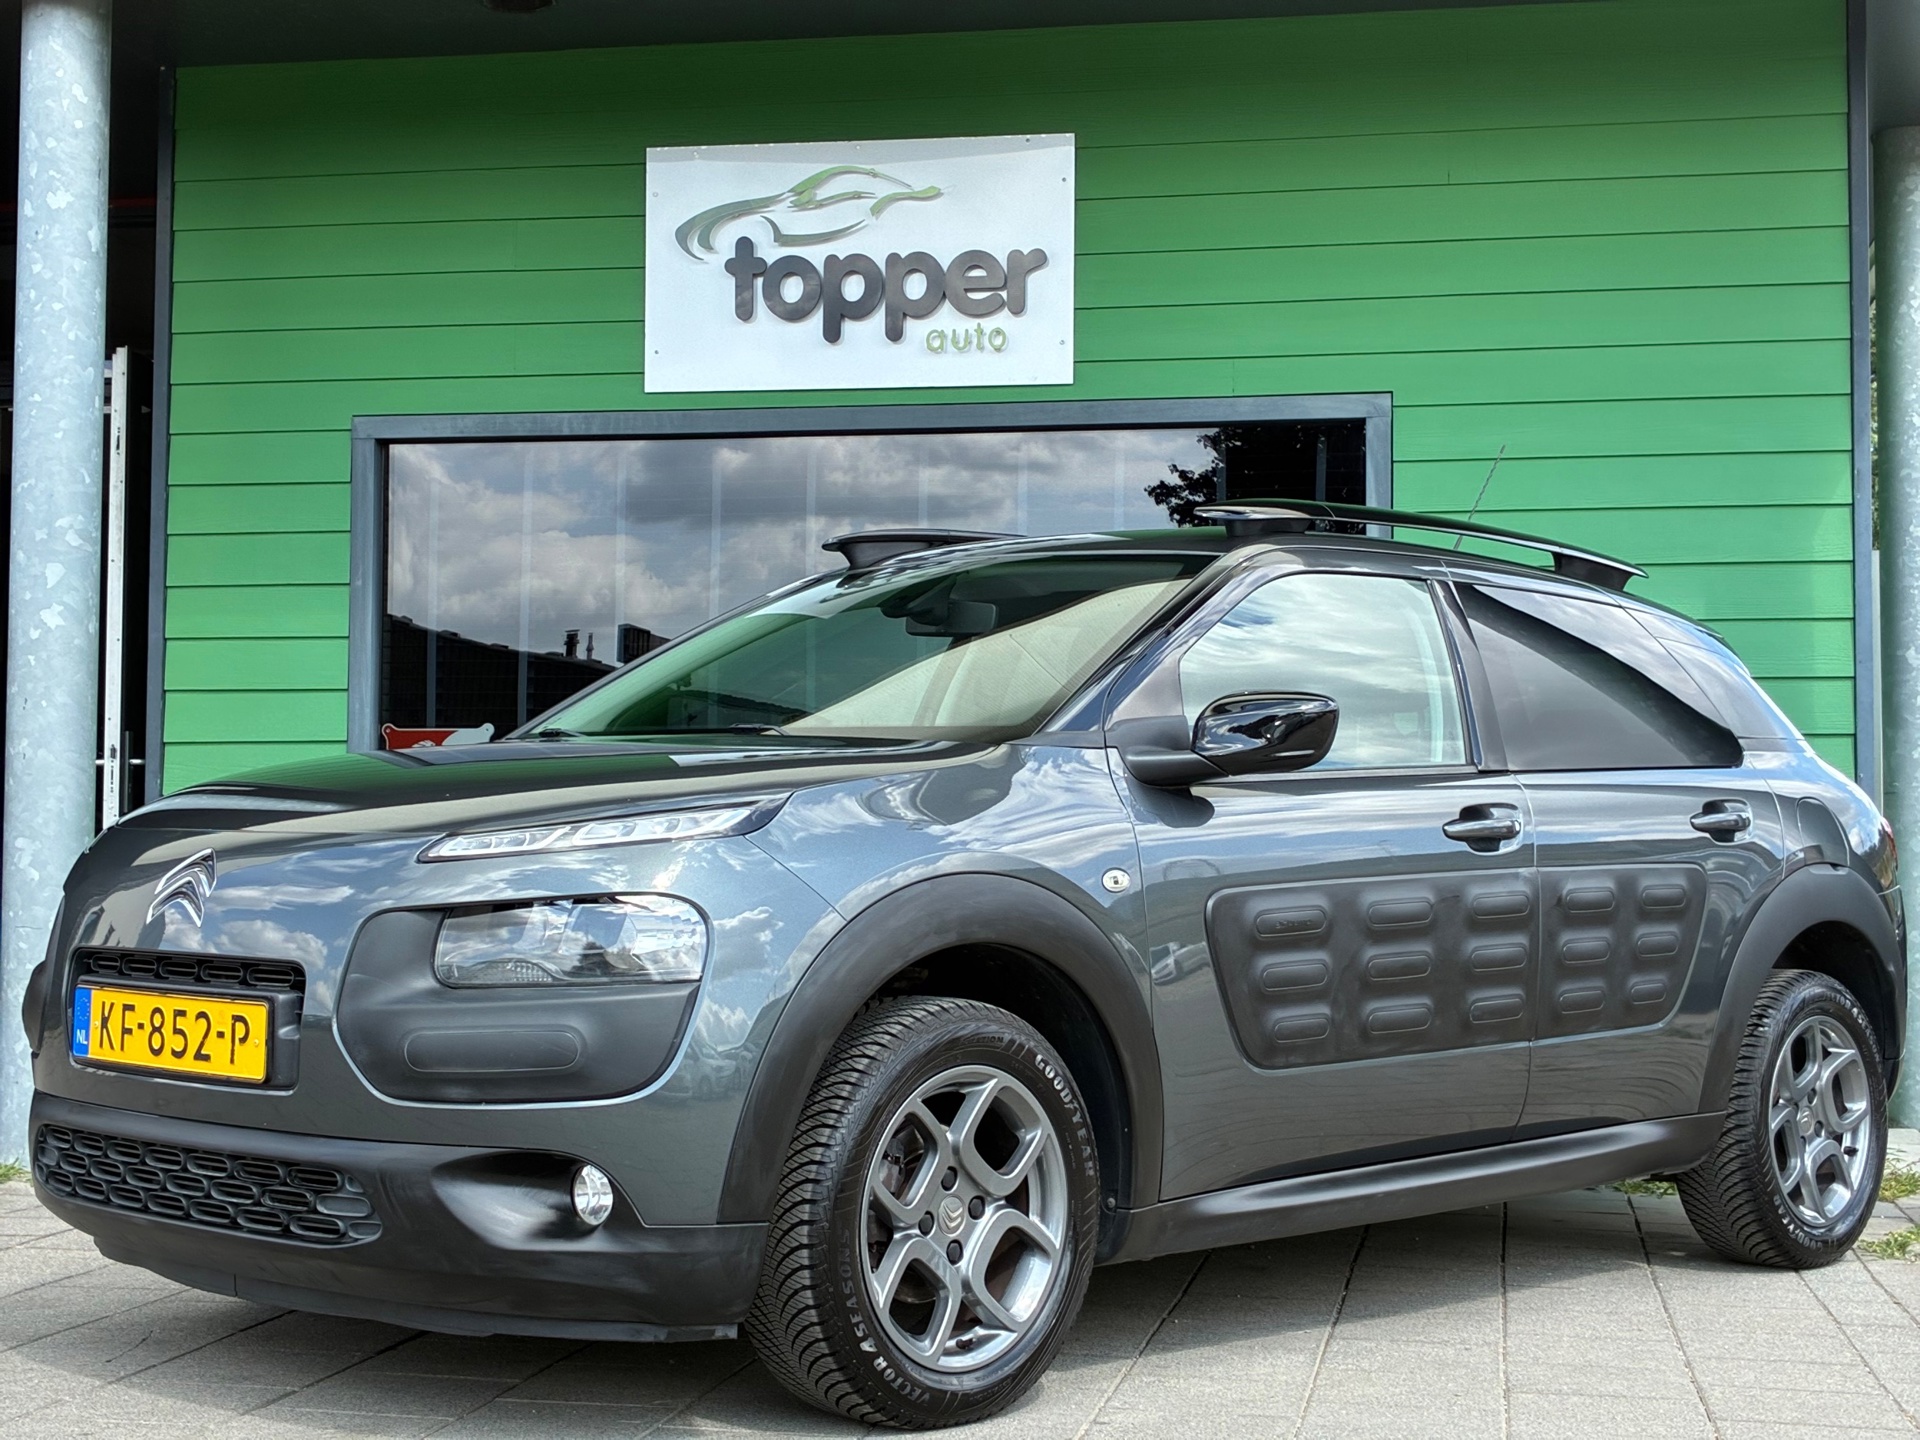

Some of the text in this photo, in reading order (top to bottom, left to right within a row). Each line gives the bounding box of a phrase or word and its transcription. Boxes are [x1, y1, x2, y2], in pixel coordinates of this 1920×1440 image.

[724, 236, 1048, 344] topper
[925, 322, 1007, 352] auto
[76, 1029, 88, 1045] NL
[99, 1001, 251, 1065] KF-852-P
[1034, 1054, 1095, 1177] GOODYEAR
[840, 1229, 931, 1404] VECTOR 4SEASONS
